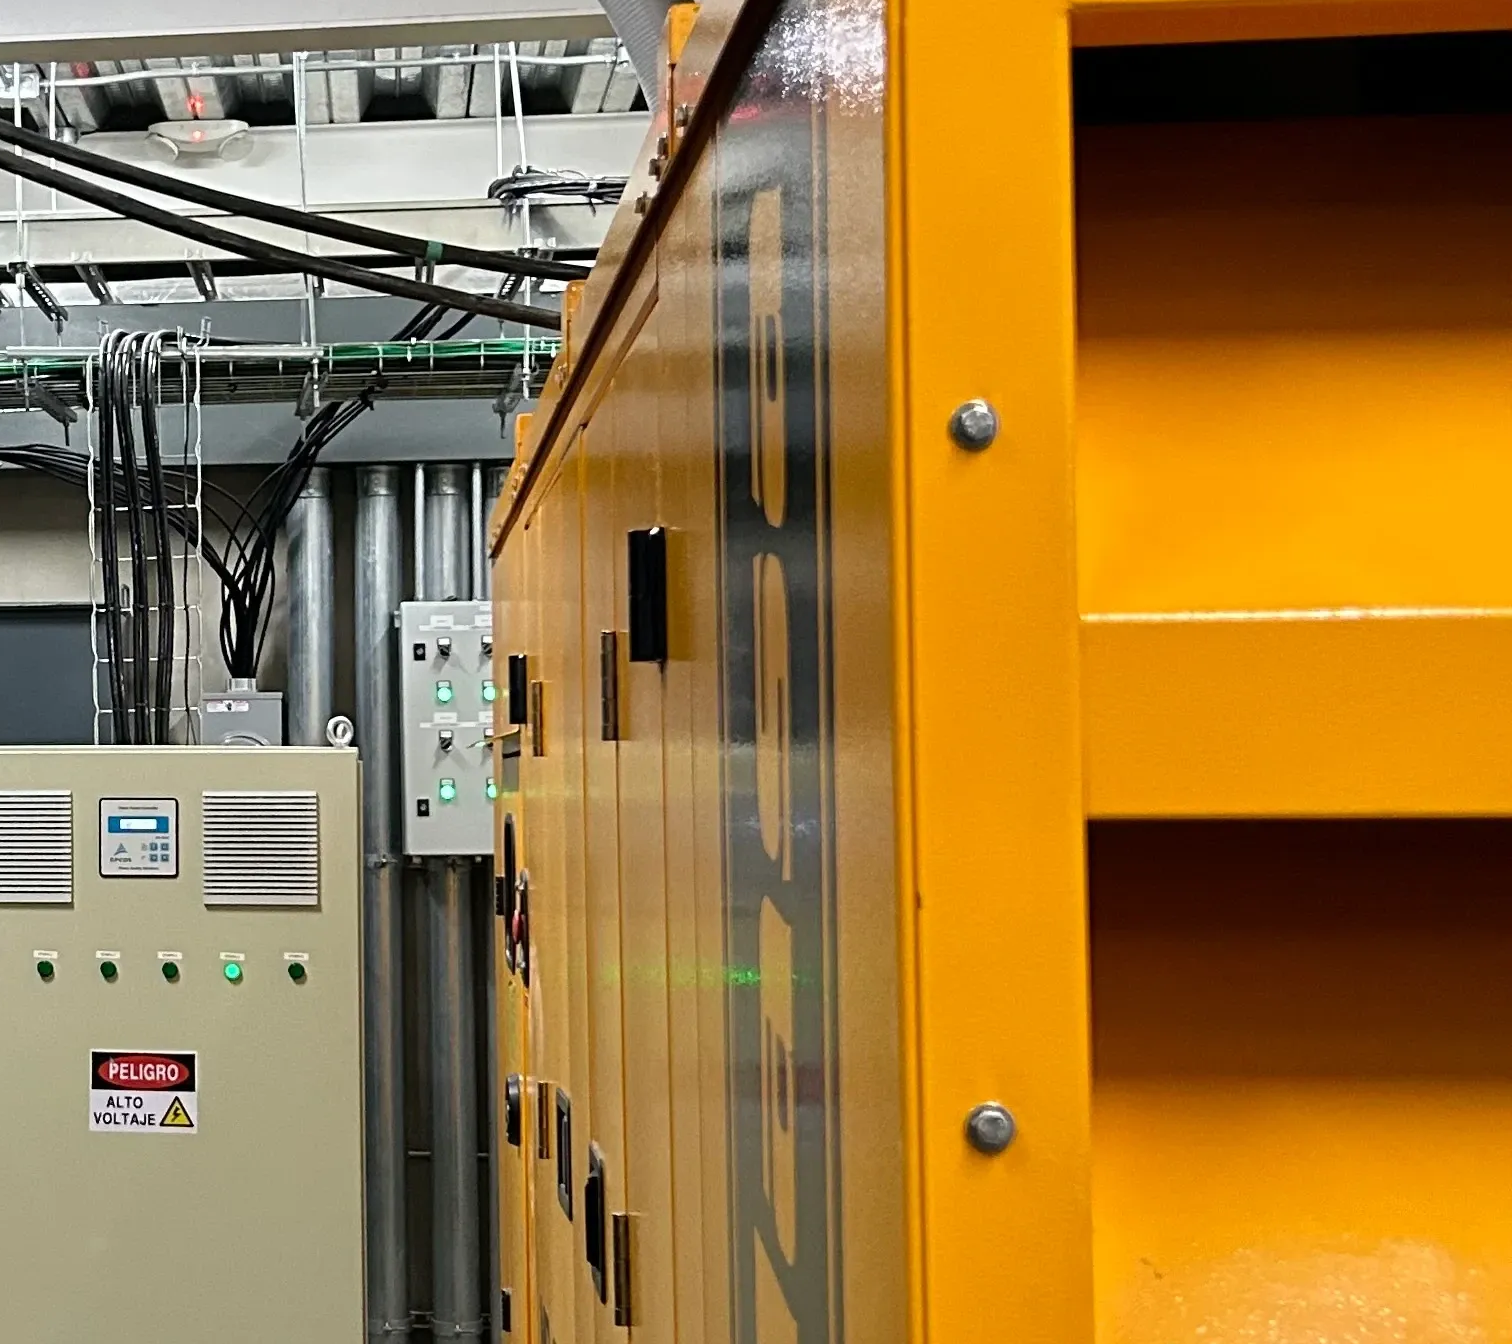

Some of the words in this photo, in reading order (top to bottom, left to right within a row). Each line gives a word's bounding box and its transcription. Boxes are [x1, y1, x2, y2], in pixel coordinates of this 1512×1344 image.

[108, 1062, 179, 1081] PELIGRO
[106, 1095, 143, 1109] ALTO
[93, 1111, 156, 1126] VOLTAJE
